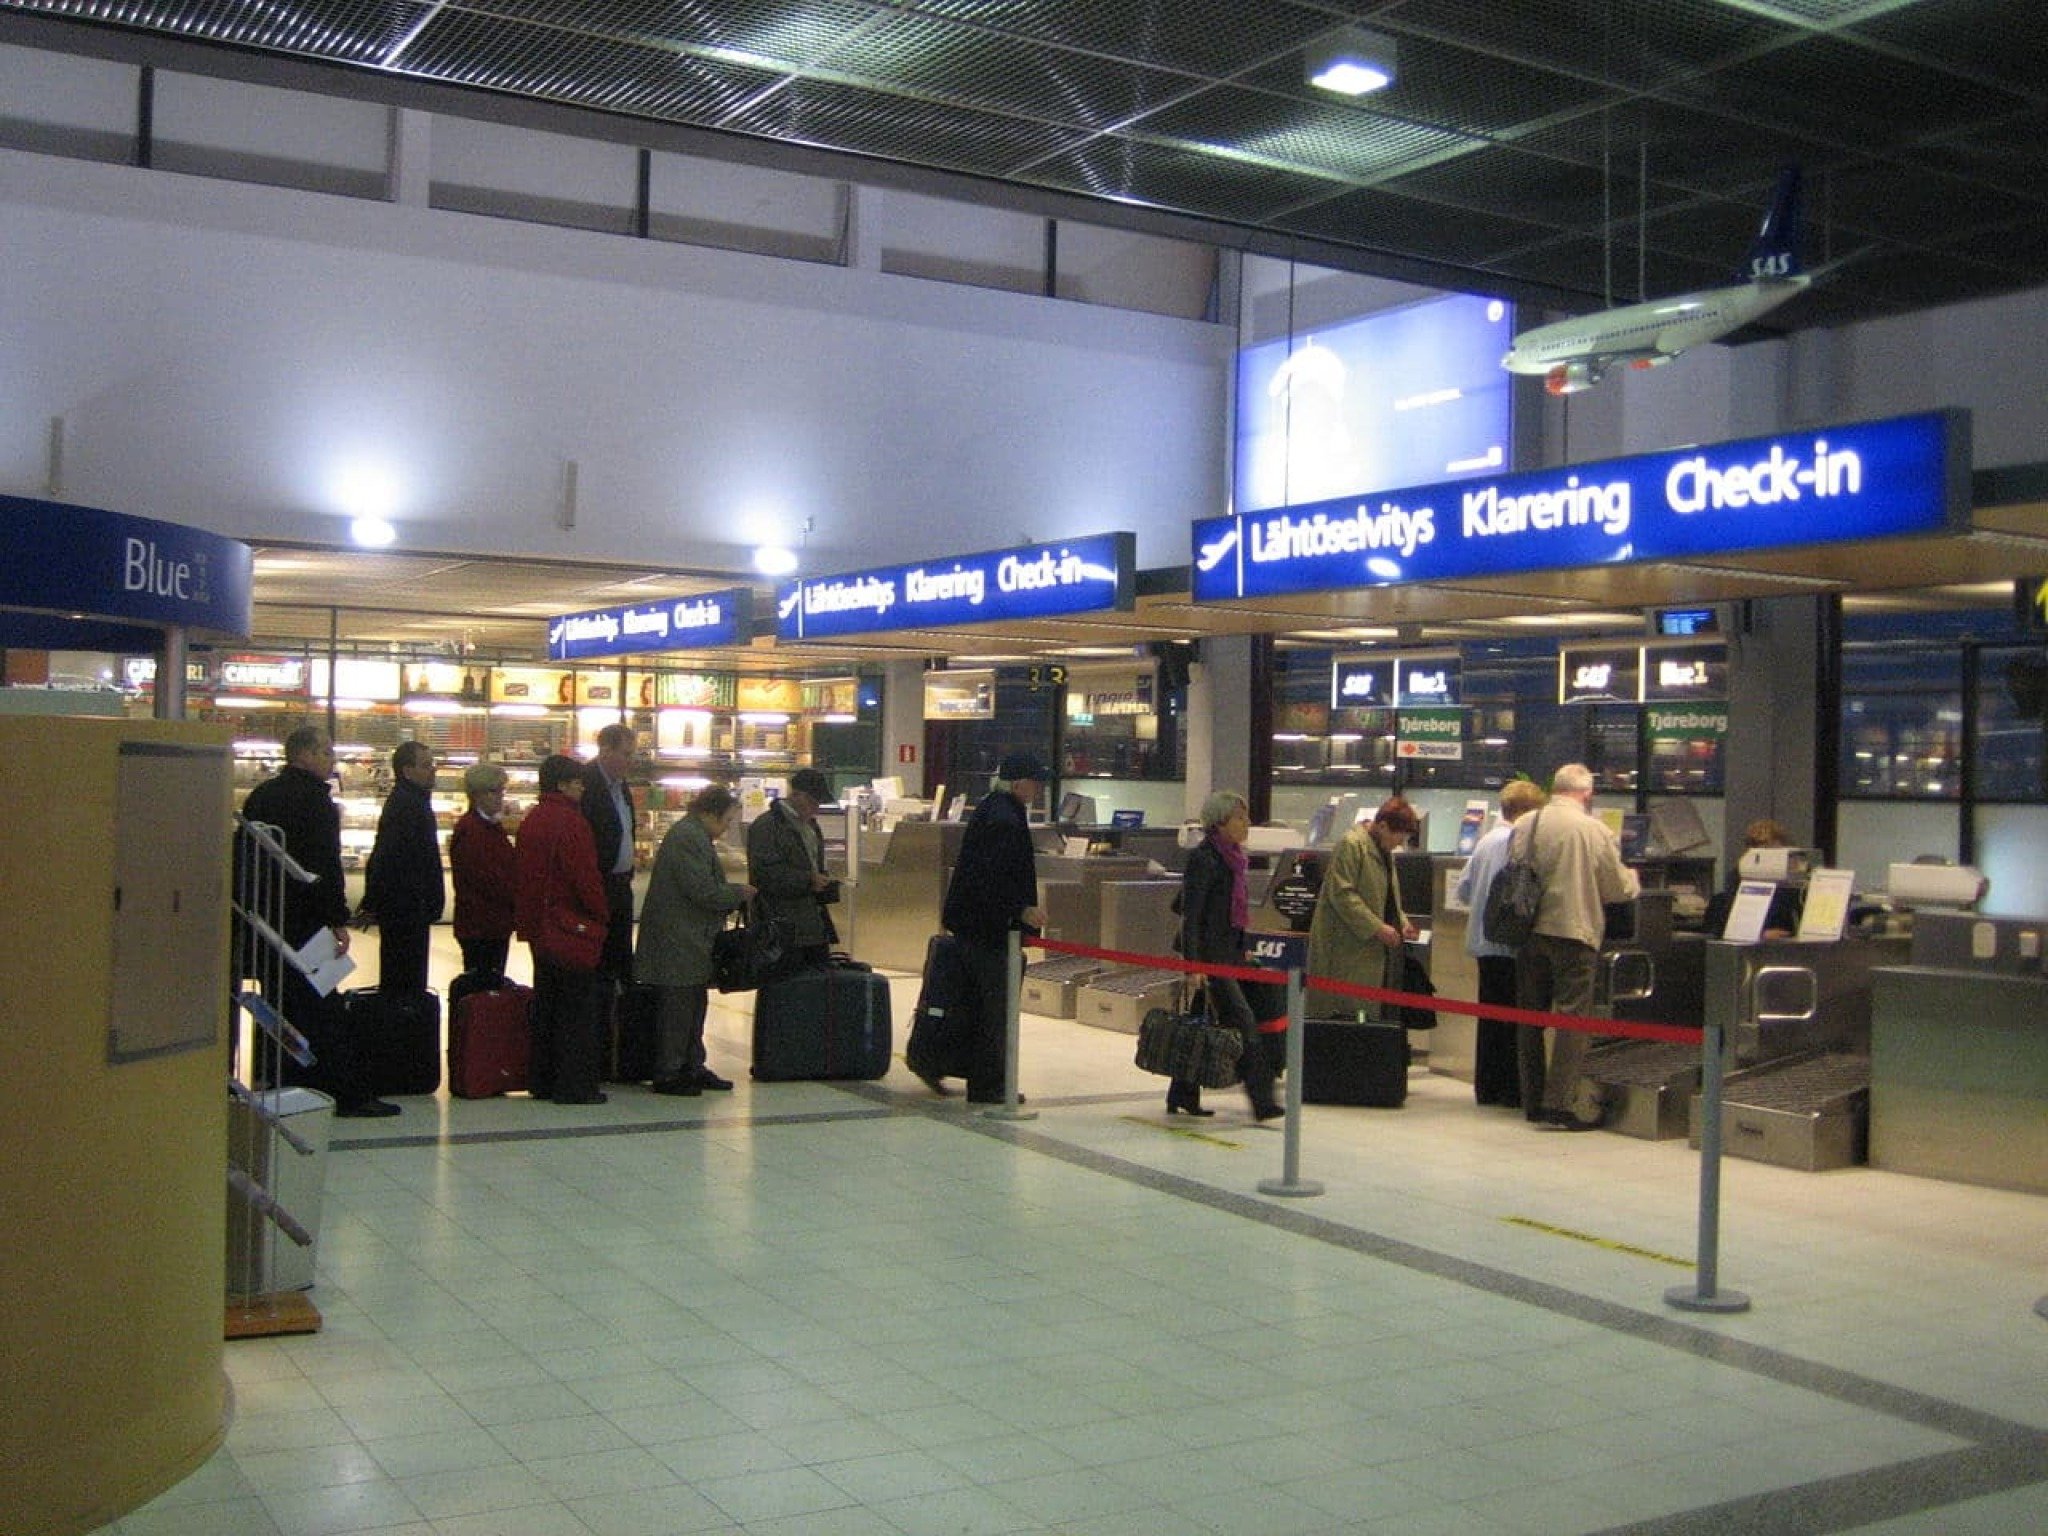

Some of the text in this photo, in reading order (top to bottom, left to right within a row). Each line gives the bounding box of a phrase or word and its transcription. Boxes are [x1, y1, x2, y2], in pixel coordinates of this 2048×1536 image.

[1751, 253, 1791, 278] SAS
[1251, 440, 1862, 562] Lähtöselvitys Klarering Check-in
[905, 564, 985, 605] Klarering
[997, 548, 1083, 593] Check-in
